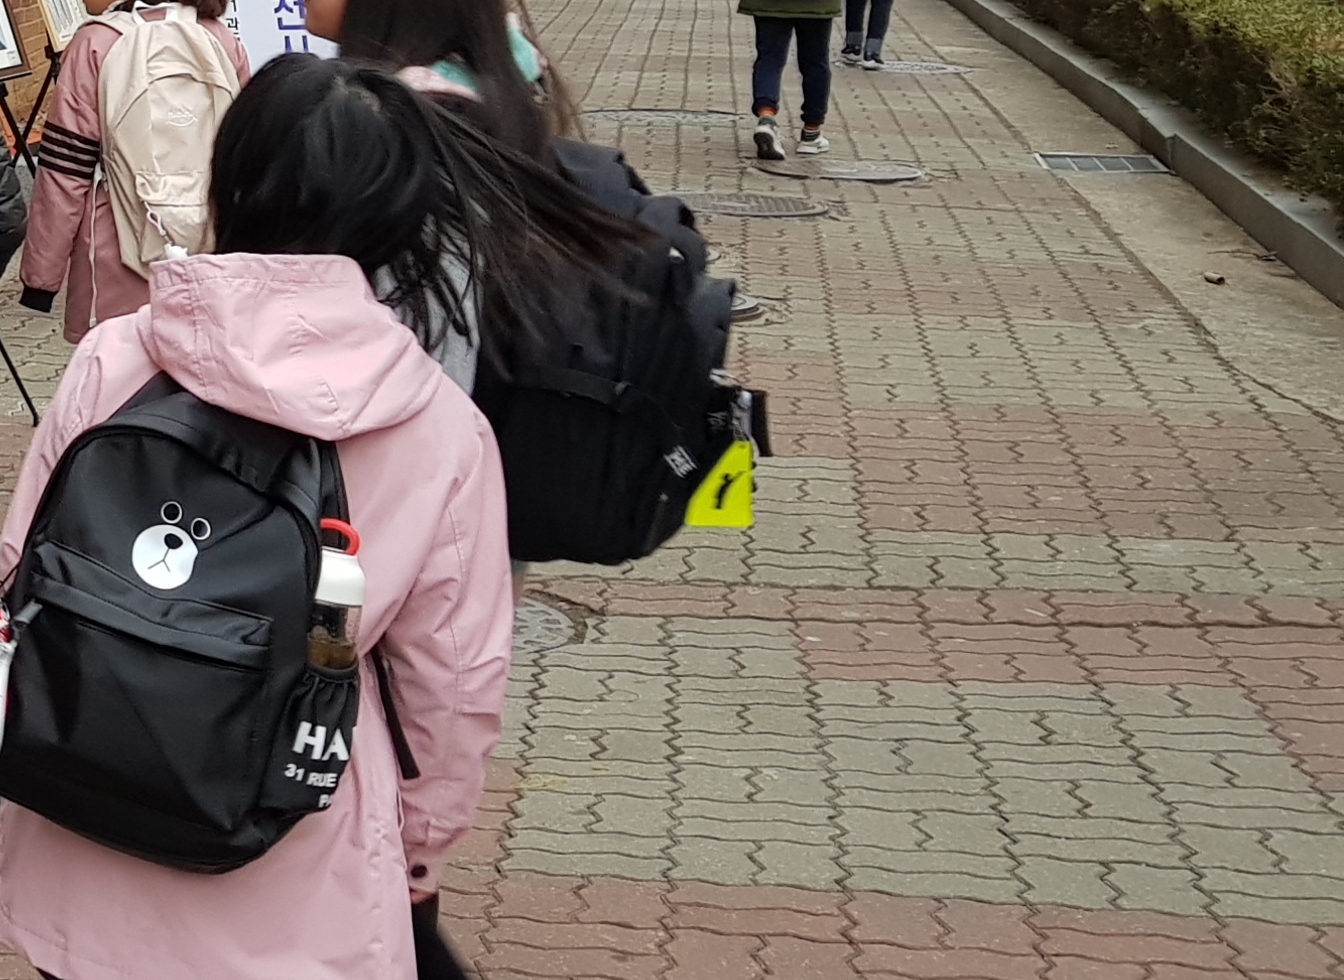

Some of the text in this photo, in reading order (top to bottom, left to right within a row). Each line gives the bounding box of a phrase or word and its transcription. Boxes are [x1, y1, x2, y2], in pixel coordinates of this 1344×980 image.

[291, 720, 358, 761] HA
[283, 762, 337, 788] 31 RUE
